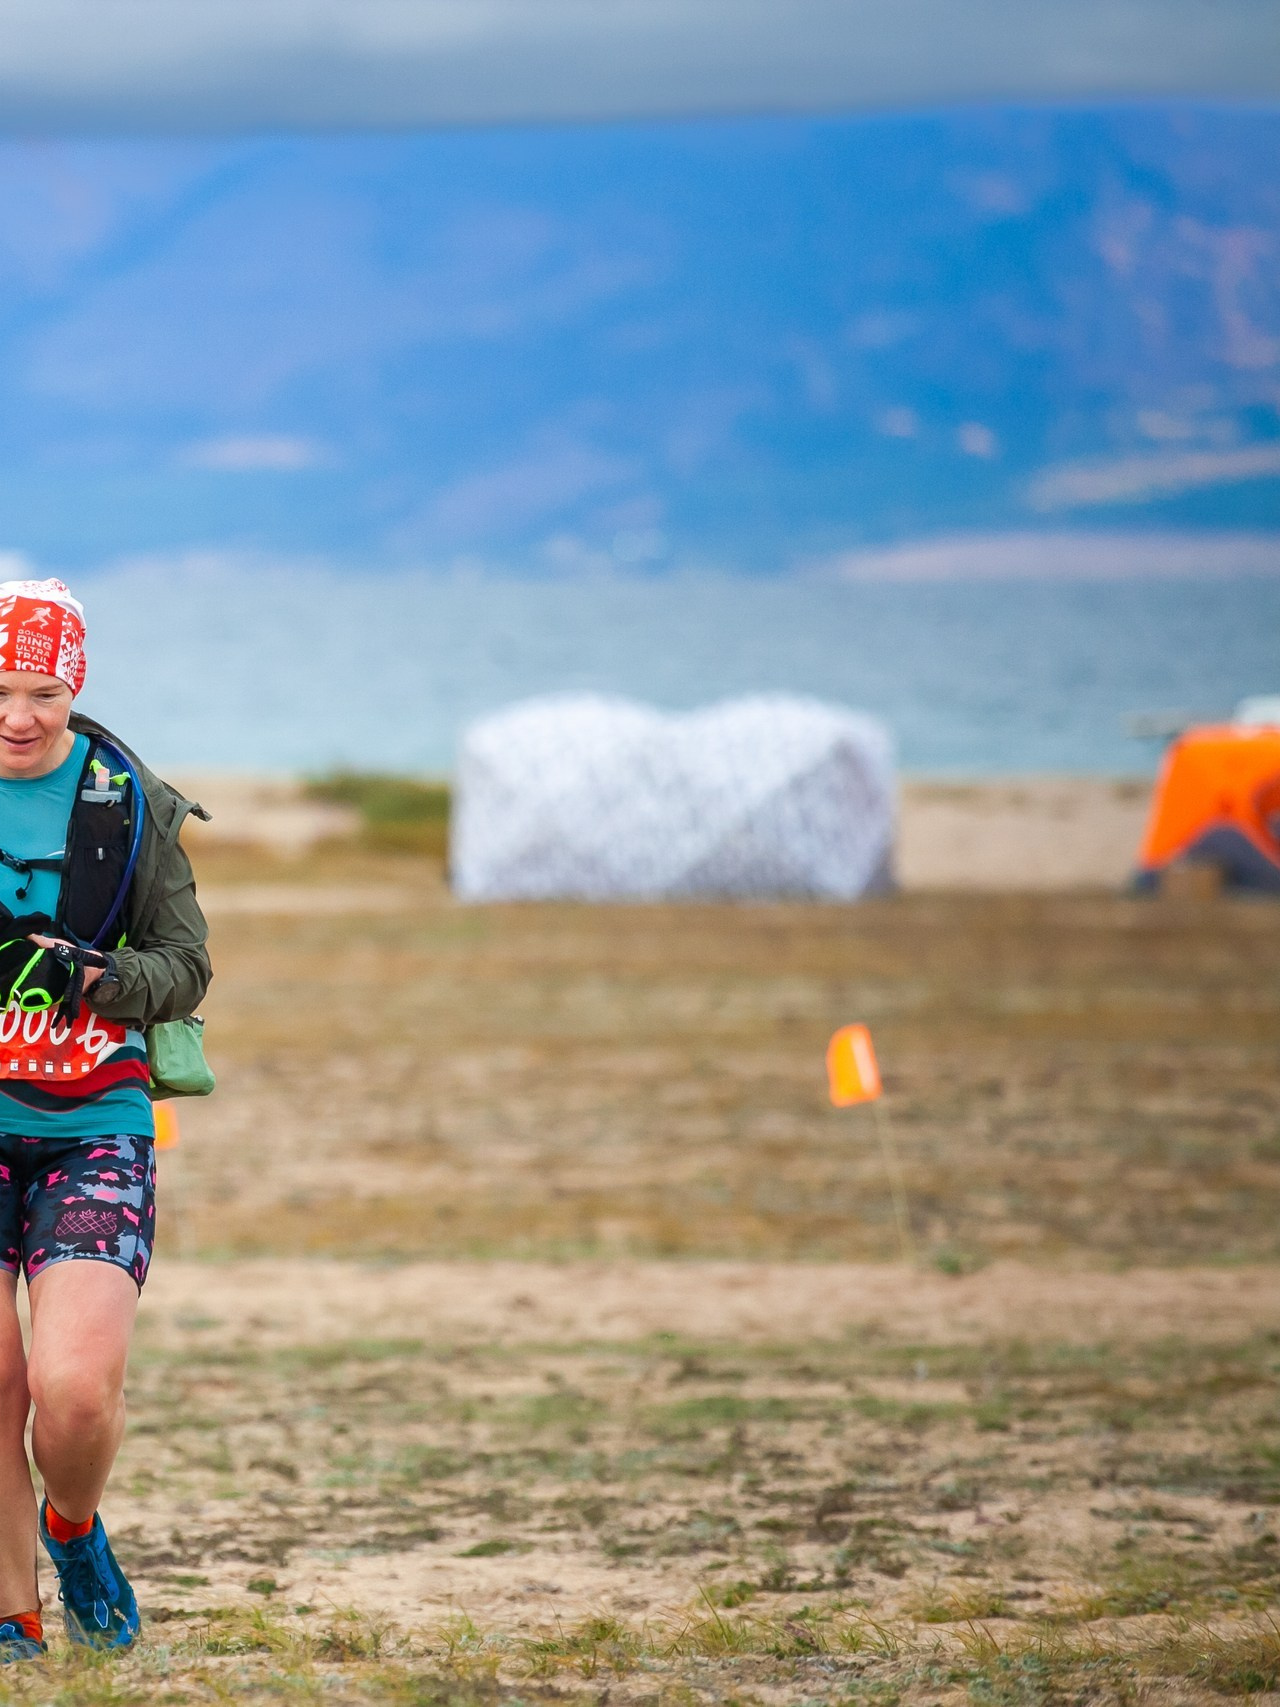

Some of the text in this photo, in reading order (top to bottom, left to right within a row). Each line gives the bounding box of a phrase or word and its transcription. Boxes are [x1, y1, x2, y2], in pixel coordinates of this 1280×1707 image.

[16, 634, 52, 651] RING
[17, 628, 54, 643] GOLDEN
[15, 644, 50, 658] ULTRA
[15, 650, 49, 666] TRAIL
